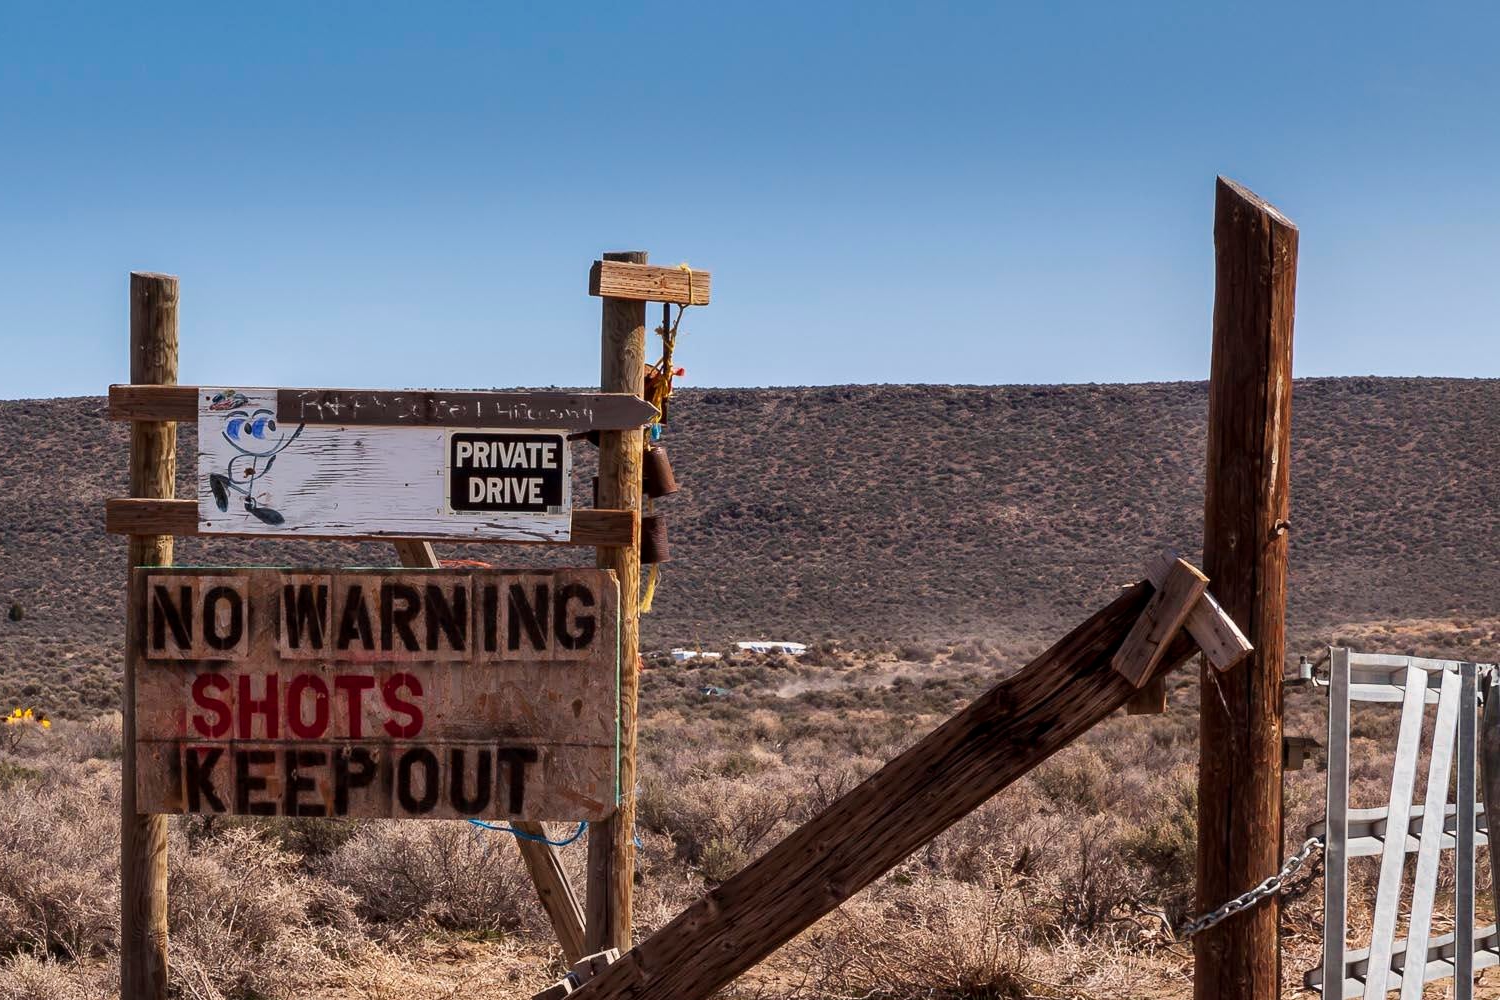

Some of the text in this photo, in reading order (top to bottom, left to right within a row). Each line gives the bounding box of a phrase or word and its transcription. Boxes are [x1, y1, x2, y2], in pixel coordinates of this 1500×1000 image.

[456, 441, 557, 469] PRIVATE
[469, 477, 544, 504] DRIVE
[153, 584, 596, 651] NO WARNING
[192, 672, 424, 738] SHOTS
[186, 747, 538, 816] KEEP OUT
